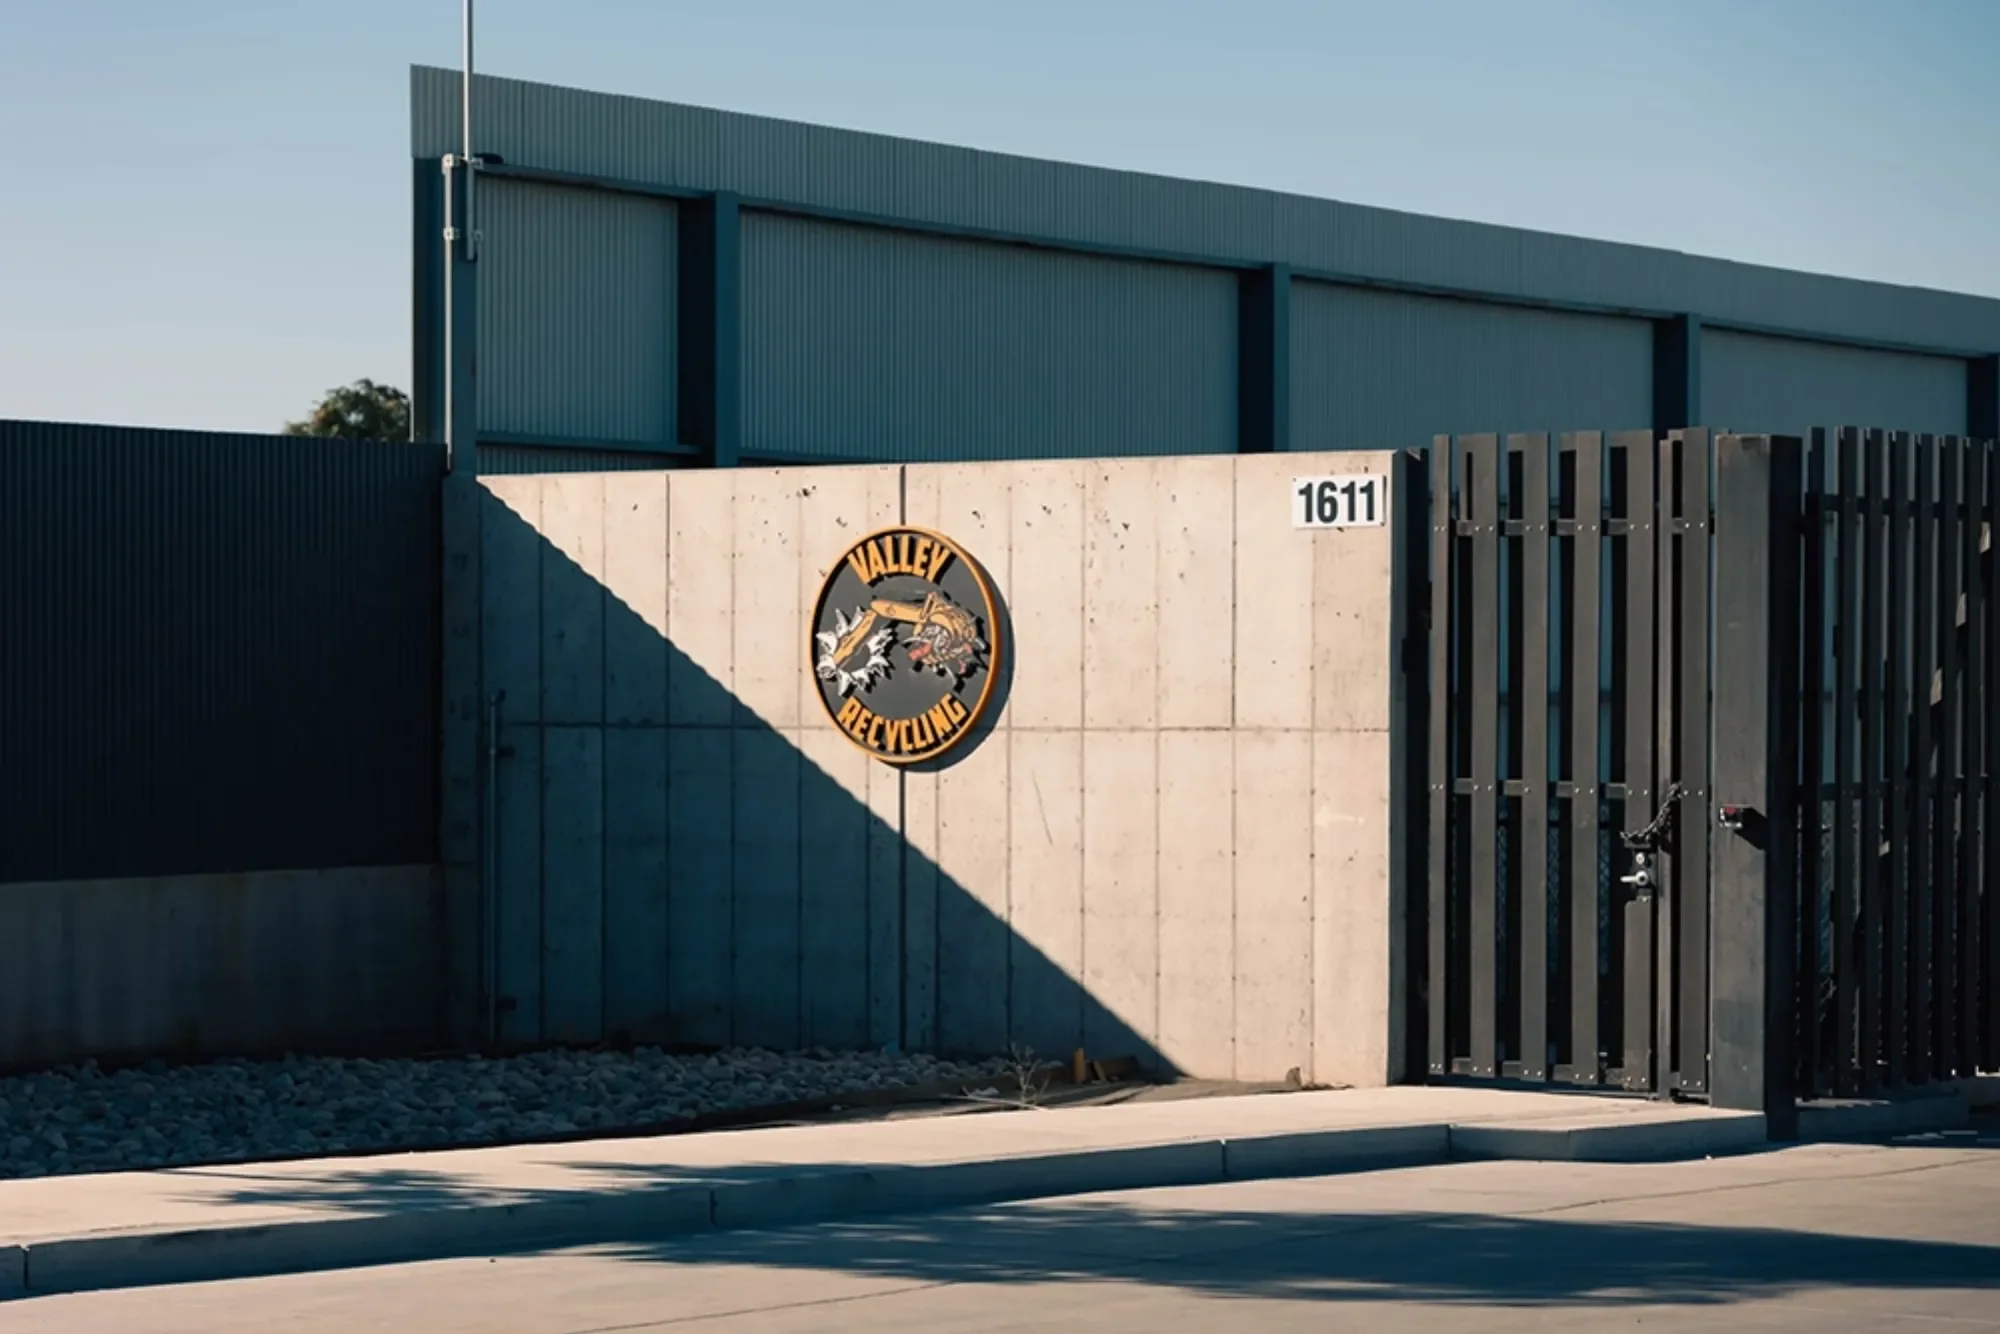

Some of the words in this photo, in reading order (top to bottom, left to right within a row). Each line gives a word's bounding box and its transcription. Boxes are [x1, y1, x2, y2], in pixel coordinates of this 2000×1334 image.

[1298, 480, 1375, 523] 1611
[848, 535, 950, 585] VALLEY
[836, 693, 967, 753] RECYCLING
